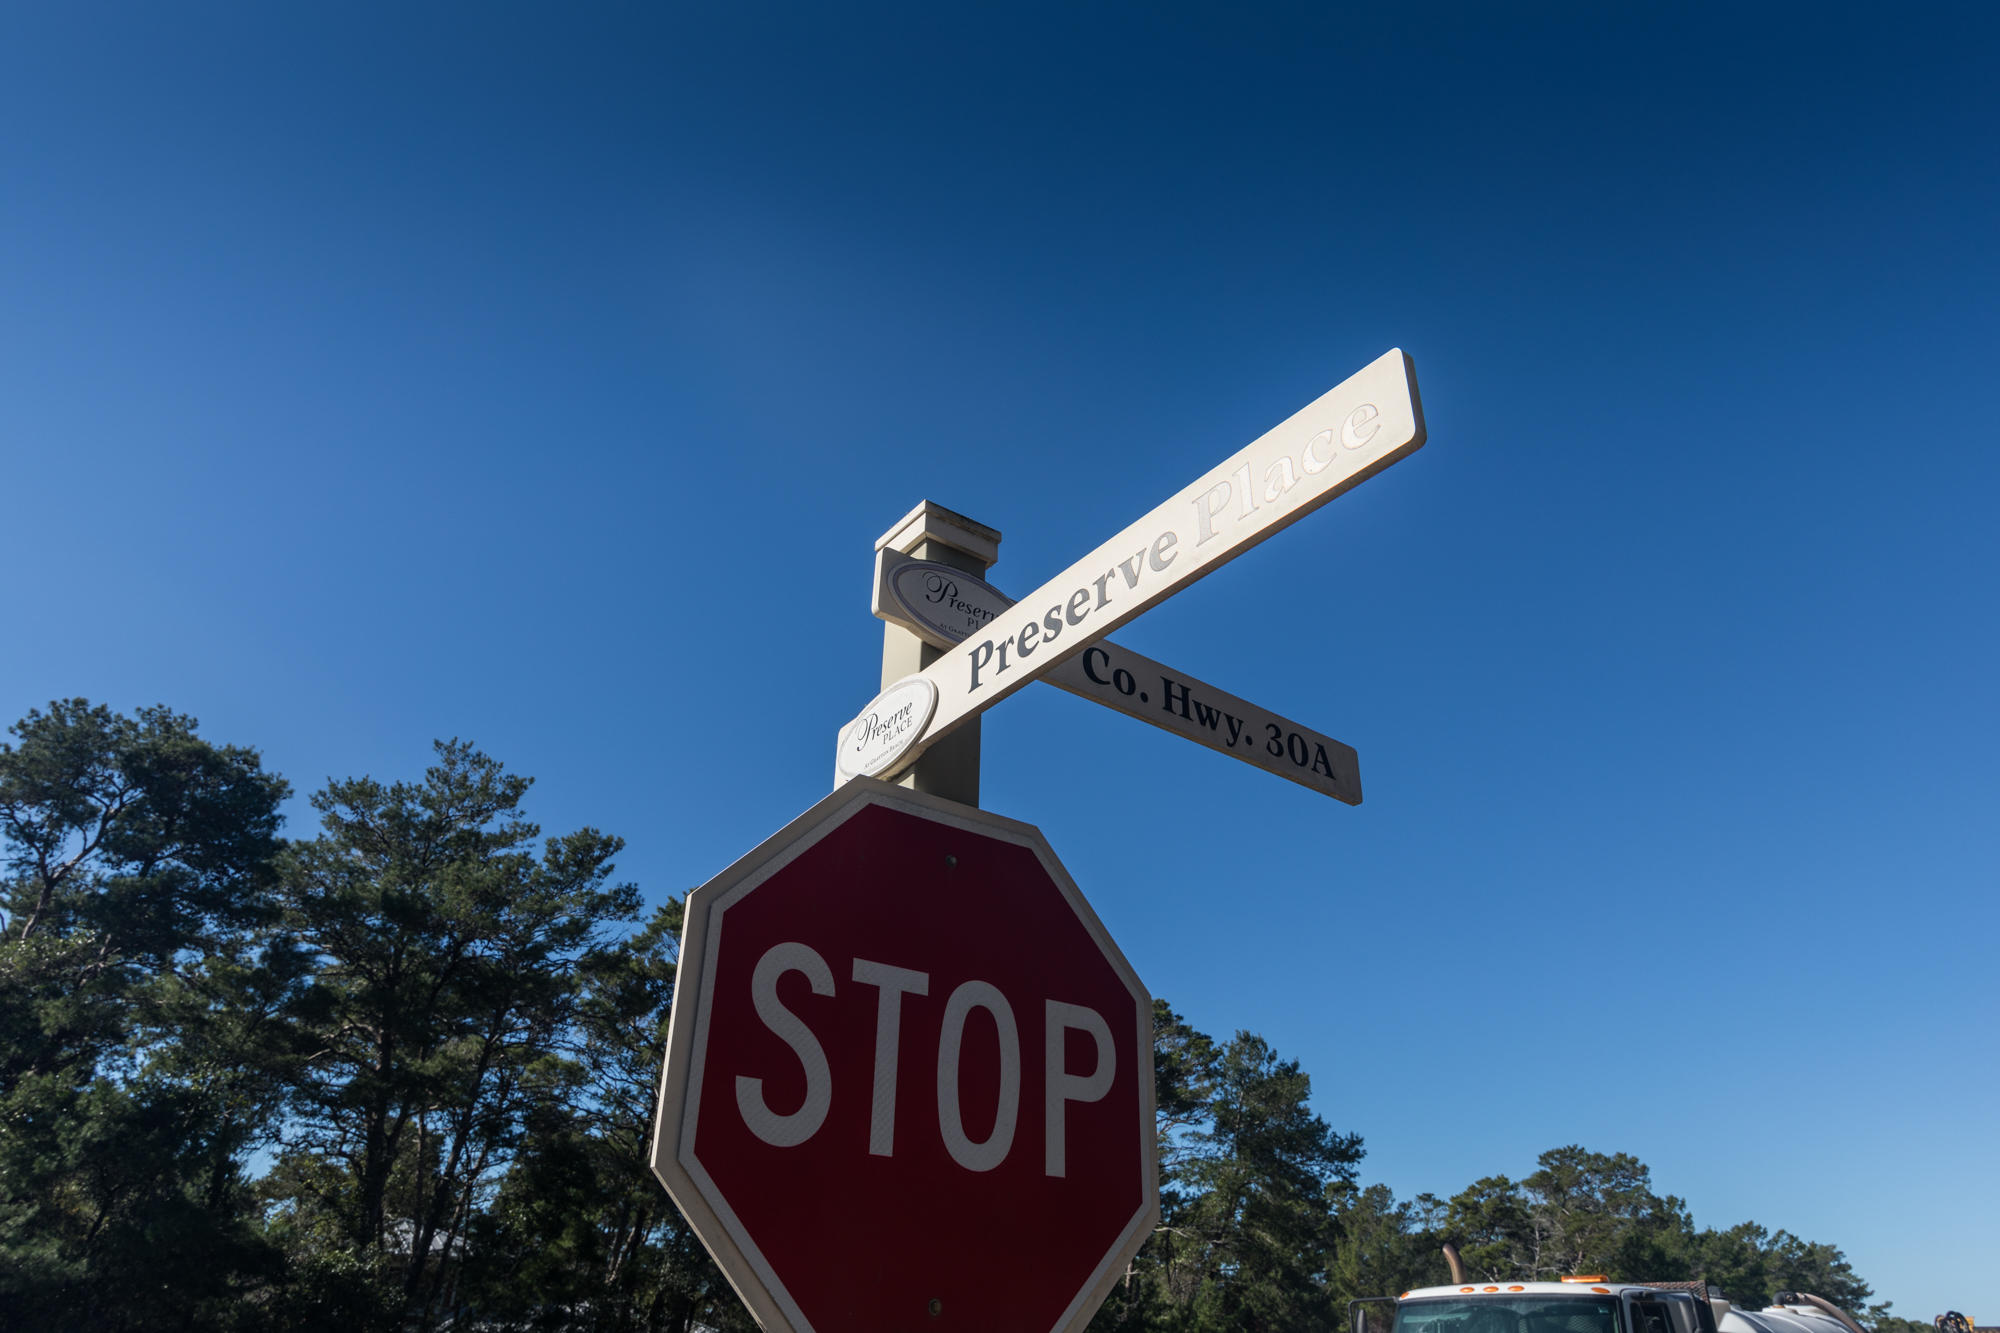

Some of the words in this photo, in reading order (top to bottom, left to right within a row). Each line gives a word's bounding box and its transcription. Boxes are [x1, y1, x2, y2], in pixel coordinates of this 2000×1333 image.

[968, 531, 1179, 694] Preserve
[1192, 403, 1381, 547] Place
[922, 571, 999, 622] Preserv
[855, 702, 913, 752] Preserve
[883, 716, 913, 744] PLACE
[1082, 647, 1149, 703] Co.
[1160, 675, 1253, 748] Hwy.
[1265, 723, 1336, 780] 30A
[735, 941, 1117, 1178] STOP
